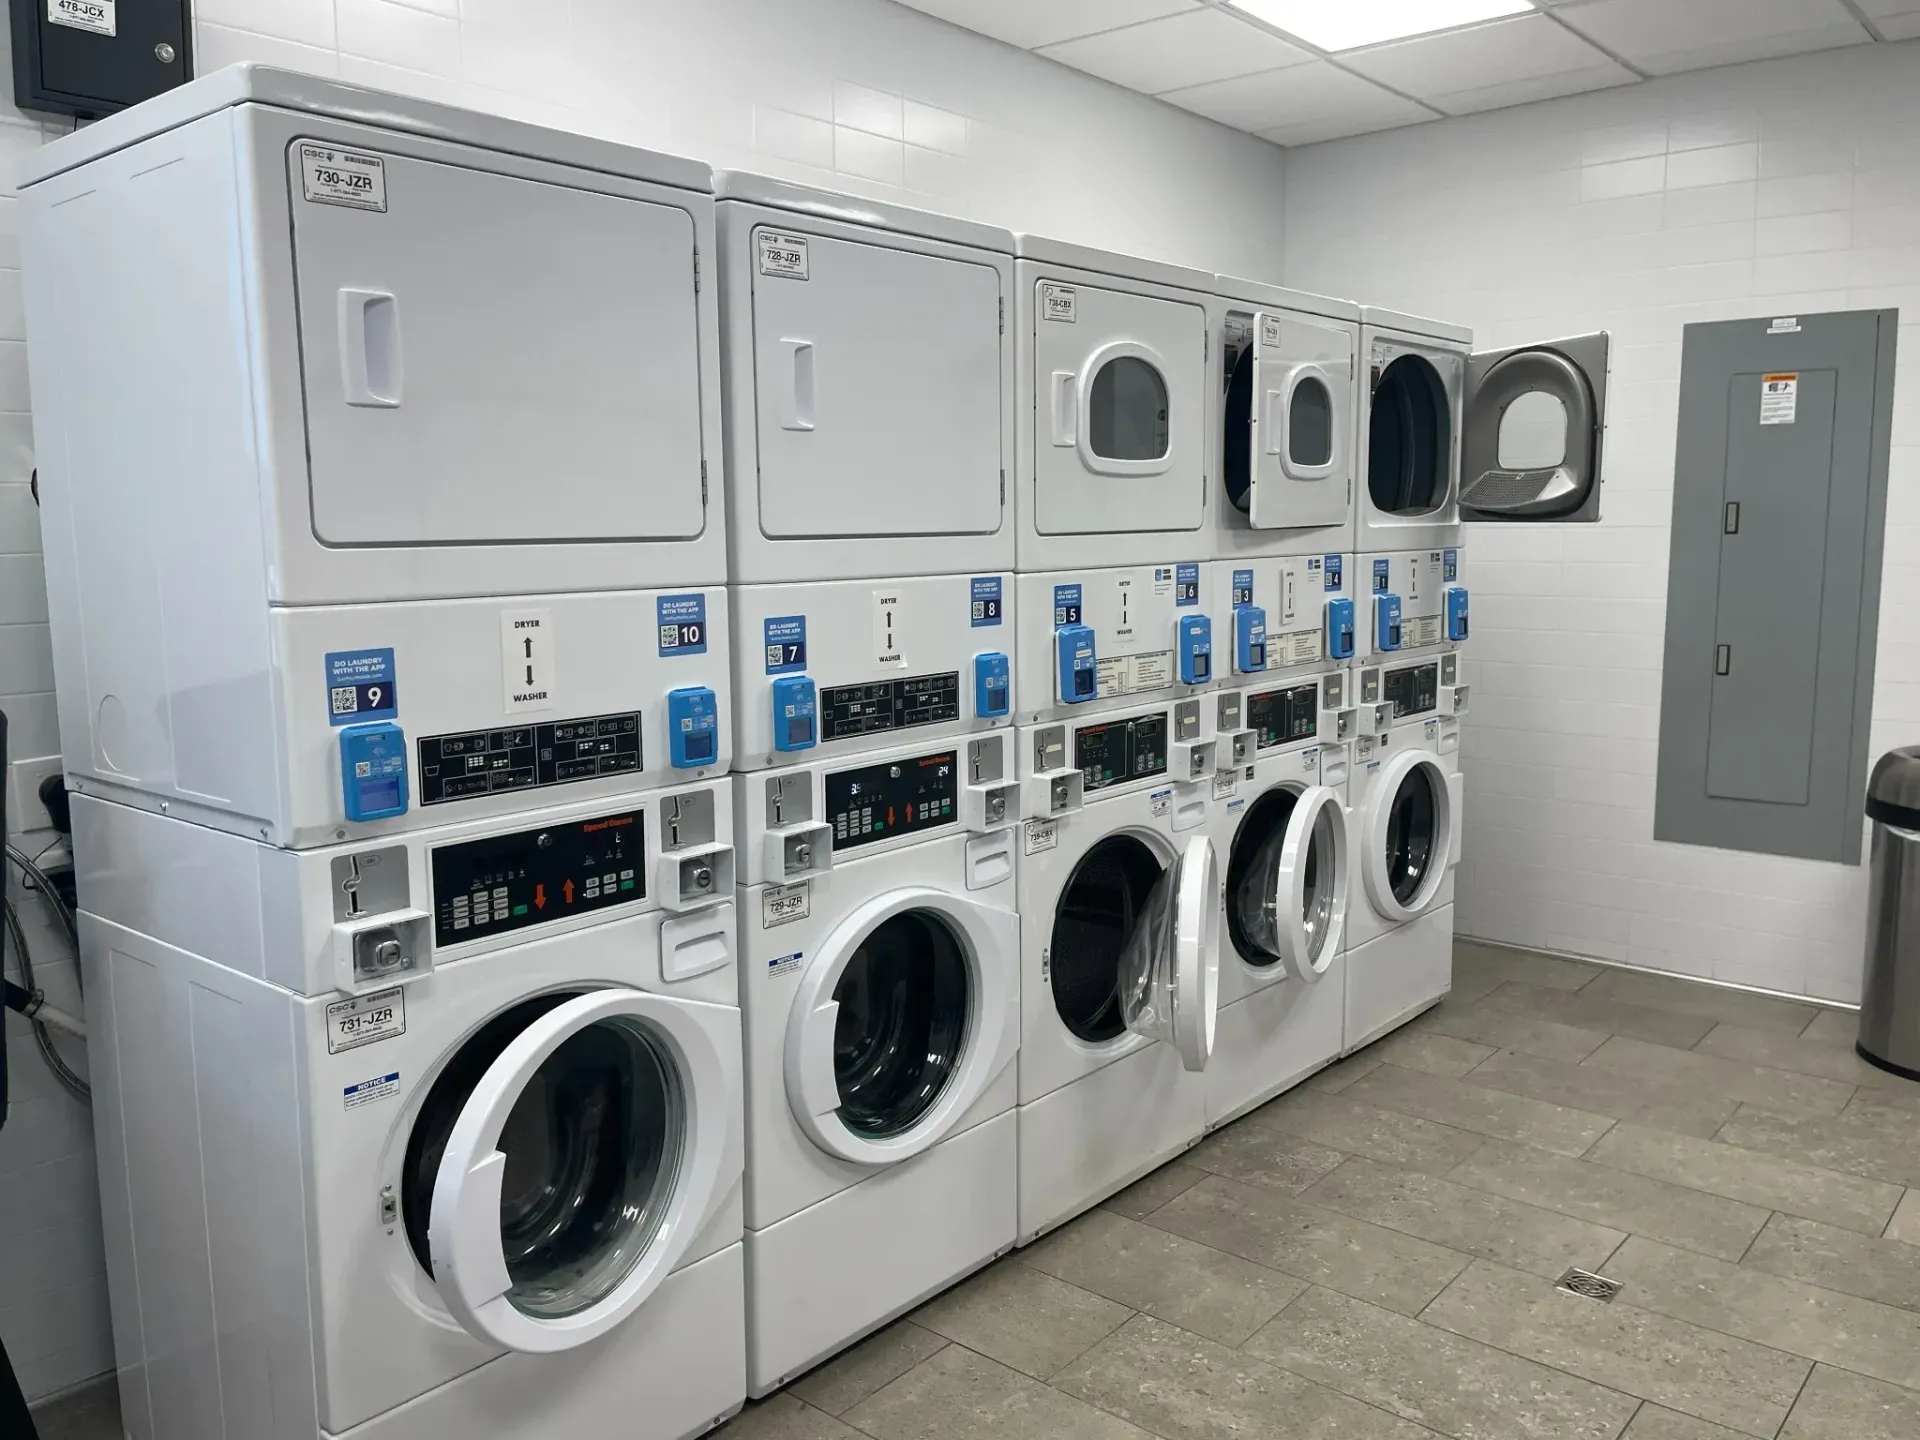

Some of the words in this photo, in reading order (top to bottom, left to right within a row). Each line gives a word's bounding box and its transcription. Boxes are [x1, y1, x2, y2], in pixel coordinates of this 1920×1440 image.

[59, 0, 105, 18] 478-JCX
[304, 148, 325, 159] CSC
[315, 169, 373, 190] 730-JZR
[766, 249, 801, 264] 728-JZR
[1333, 574, 1338, 584] 4
[1188, 585, 1194, 597] 6
[1243, 590, 1249, 602] 3
[880, 597, 897, 605] DRYER
[988, 602, 995, 616] 8
[1070, 608, 1076, 621] 5
[514, 619, 540, 629] DRYER
[681, 626, 699, 643] 10
[789, 645, 798, 662] 7
[879, 654, 901, 663] WASHER
[347, 657, 383, 667] LAUNDRY
[333, 667, 353, 675] WITH
[355, 665, 369, 673] THE
[370, 664, 386, 672] APP
[367, 686, 382, 708] 9
[513, 691, 548, 703] WASHER
[770, 896, 803, 912] 729-JZR
[329, 1003, 349, 1015] CSC
[339, 1008, 393, 1032] 731-JZR
[357, 1077, 386, 1090] NOTICE
